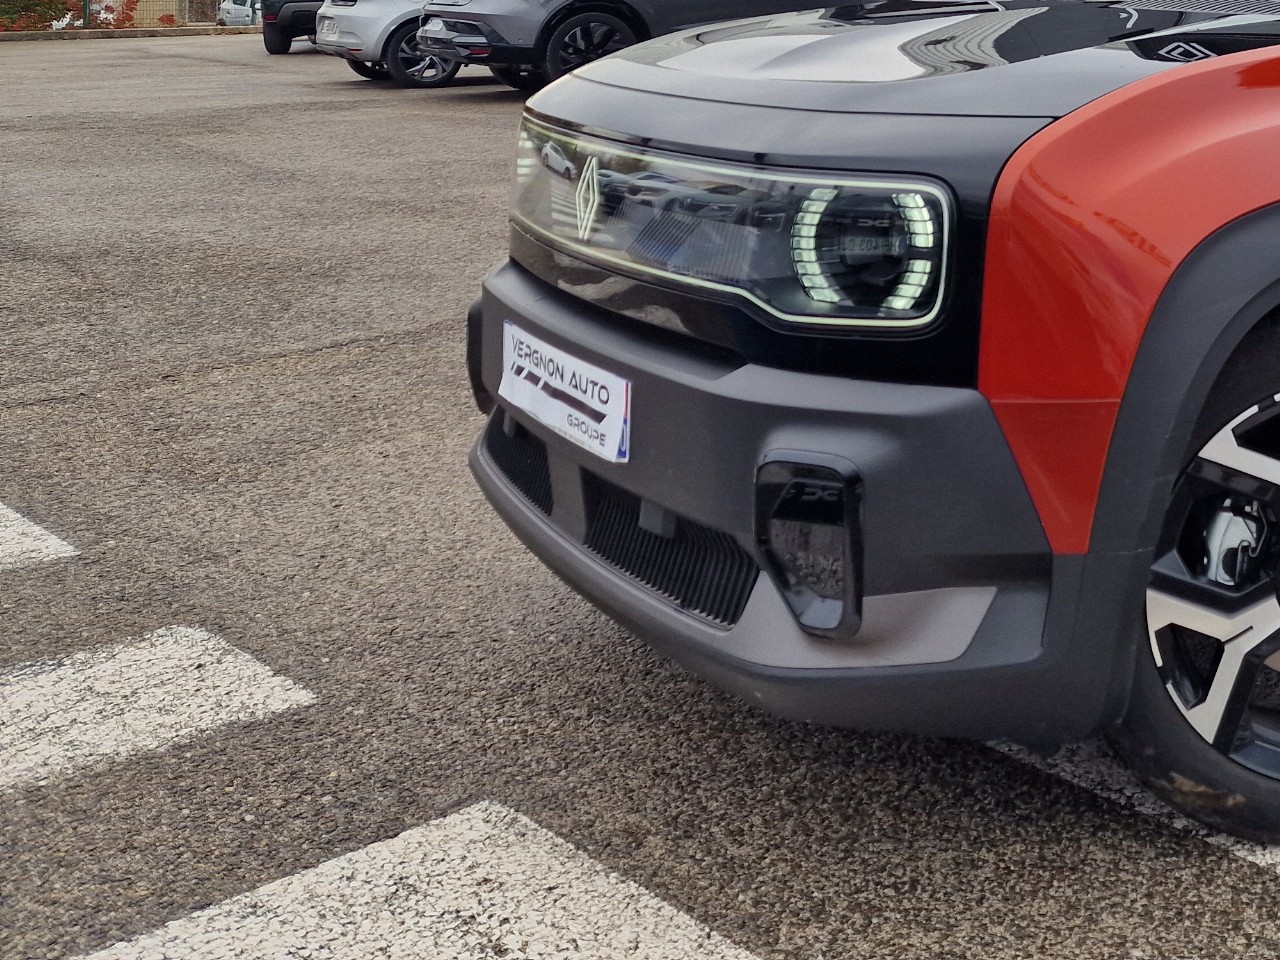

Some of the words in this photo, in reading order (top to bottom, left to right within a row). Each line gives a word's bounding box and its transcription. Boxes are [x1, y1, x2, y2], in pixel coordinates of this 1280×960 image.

[512, 335, 564, 383] VERGNON
[569, 371, 610, 405] AUTO
[567, 414, 606, 447] GROUPE
